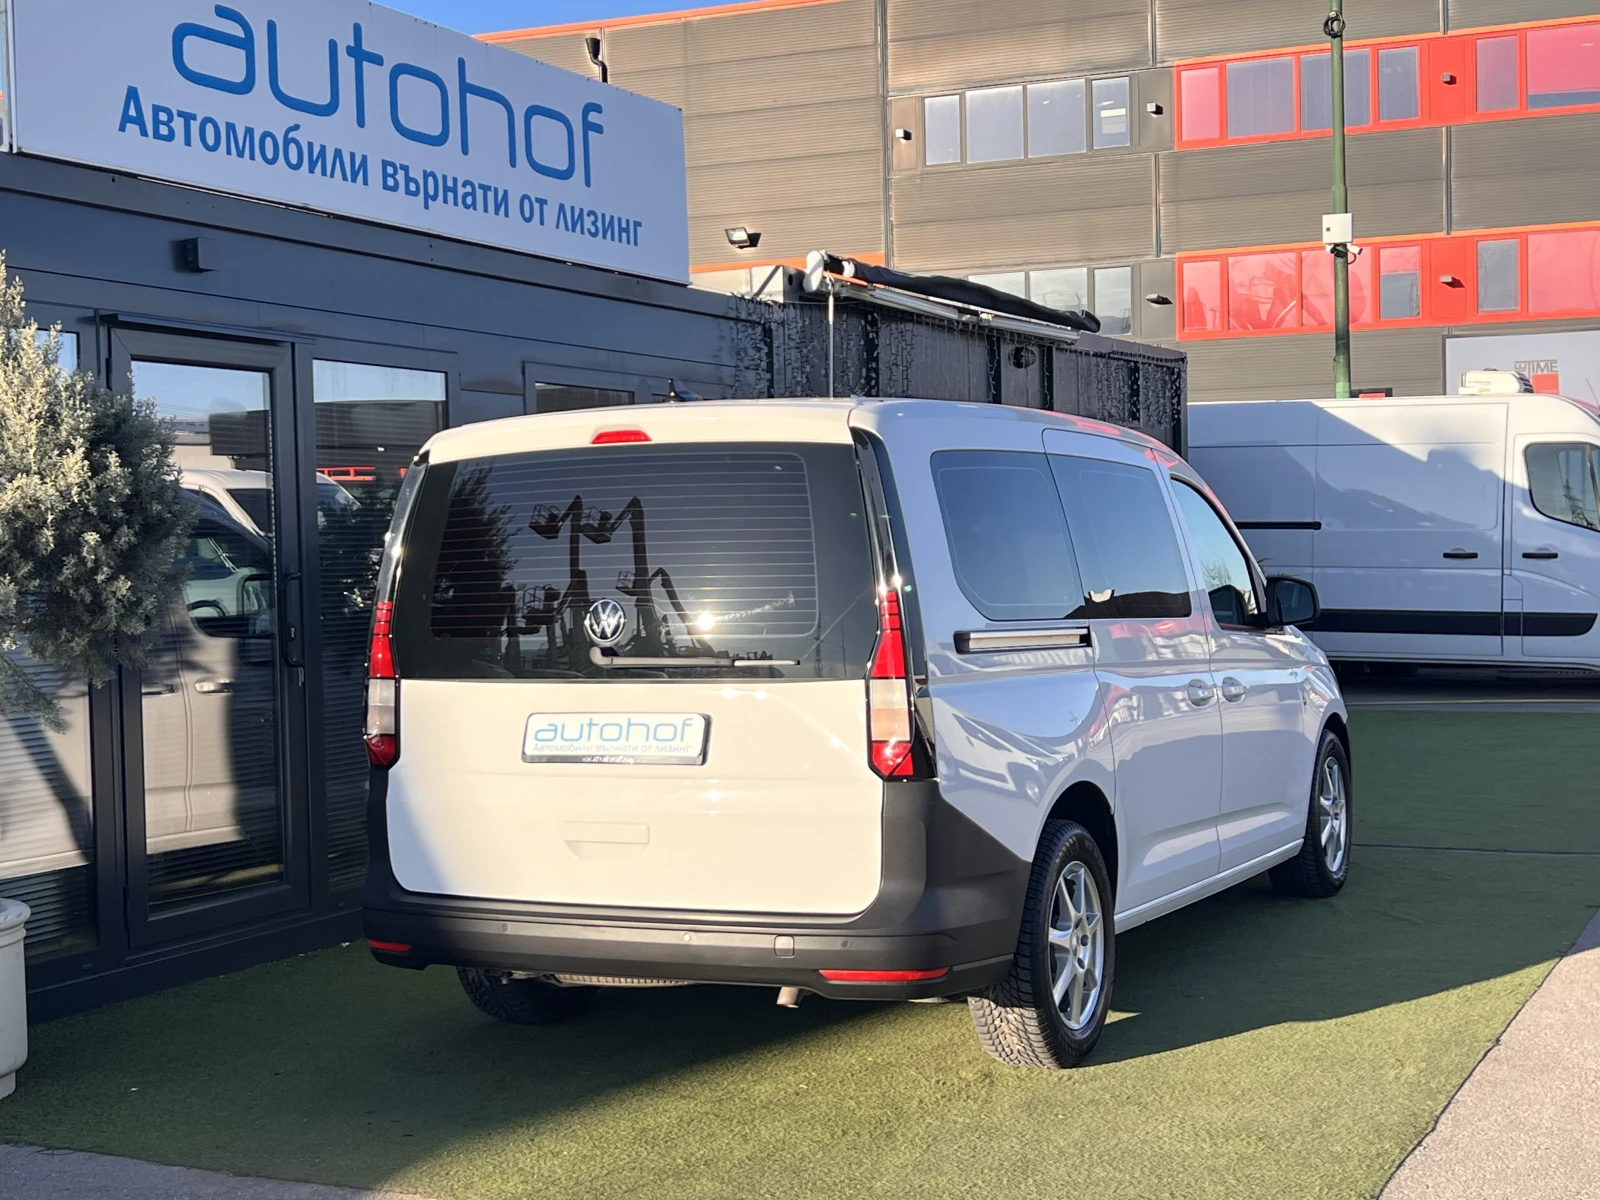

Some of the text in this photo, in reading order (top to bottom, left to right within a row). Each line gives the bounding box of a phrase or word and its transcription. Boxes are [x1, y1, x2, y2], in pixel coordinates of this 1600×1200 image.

[118, 85, 643, 247] Автомобили върнати от лизинг
[172, 4, 604, 187] autohof
[534, 718, 693, 742] autohof
